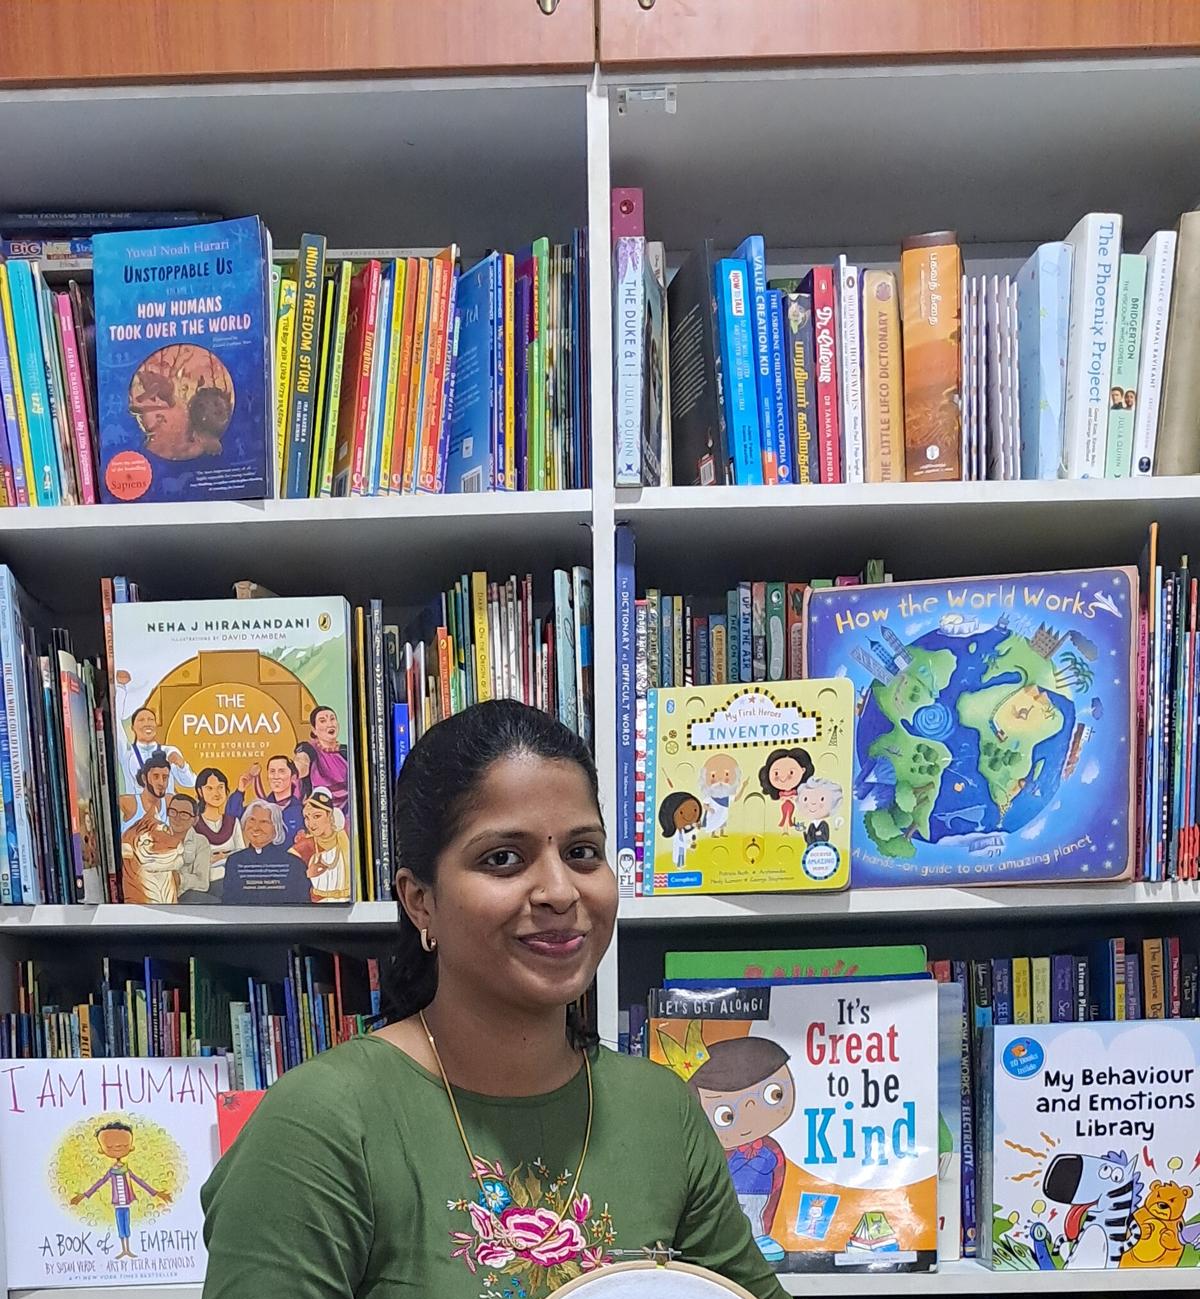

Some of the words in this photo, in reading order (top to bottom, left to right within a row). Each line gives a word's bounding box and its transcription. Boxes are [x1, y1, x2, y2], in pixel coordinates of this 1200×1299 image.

[127, 246, 156, 259] Yuval
[161, 245, 190, 256] Noah
[194, 240, 229, 252] Harari
[1098, 222, 1114, 256] The
[124, 262, 209, 283] Unstoppable
[216, 258, 233, 275] Us
[304, 247, 318, 288] INDIA'S
[732, 272, 740, 288] HOW
[755, 255, 764, 292] VALUE
[624, 280, 636, 304] THE
[770, 294, 778, 308] THE
[1090, 264, 1112, 336] Phoenix
[138, 303, 166, 319] HOW
[171, 296, 222, 316] HUMANS
[734, 298, 743, 314] TALK
[816, 307, 832, 326] Dr
[110, 325, 142, 340] TOOK
[146, 322, 176, 338] OVER
[181, 319, 204, 335] THE
[209, 314, 251, 333] WORLD
[301, 294, 315, 350] FREEDOM
[624, 310, 636, 345] DUKE
[756, 297, 767, 353] CREATION
[771, 312, 780, 350] USBORNE
[1127, 298, 1139, 359] BRIDGERTON
[817, 330, 834, 383] Cuterus
[879, 312, 889, 378] DICTIONARY
[297, 355, 311, 393] STORY
[760, 356, 769, 375] KID
[773, 352, 783, 400] CHILDREN'S
[1089, 342, 1105, 403] Project
[1150, 349, 1159, 388] RAVIKANT
[625, 384, 634, 415] JULIA
[824, 396, 831, 405] DR
[880, 383, 890, 413] LIFCO
[625, 420, 634, 457] QUINN
[776, 403, 786, 463] ENCYCLOPEDIA
[881, 419, 891, 455] LITTLE
[1115, 441, 1123, 467] QUINN
[881, 462, 891, 482] THE
[112, 481, 146, 492] Sapiens
[742, 597, 750, 608] UP
[835, 608, 888, 634] How
[898, 593, 938, 618] the
[948, 585, 1015, 608] World
[1023, 587, 1098, 619] Works
[147, 621, 186, 632] NEHA
[191, 621, 198, 631] J
[205, 618, 310, 630] HIRANANDANI
[621, 591, 630, 650] DICTIONARY
[742, 612, 750, 624] IN
[251, 632, 286, 640] YAMBEM
[742, 630, 750, 646] THE
[5, 662, 14, 676] THE
[6, 679, 15, 696] GIRL
[621, 663, 630, 710] DIFFICULT
[8, 698, 16, 717] WHO
[216, 693, 245, 708] THE
[183, 711, 281, 735] PADMAS
[725, 713, 737, 722] My
[739, 708, 756, 717] First
[759, 708, 781, 718] Heroes
[9, 719, 18, 741] COULD
[622, 713, 630, 746] WORDS
[709, 722, 799, 740] INVENTORS
[11, 744, 19, 758] FIX
[200, 750, 265, 758] PERSEVERANCE
[12, 761, 23, 798] ANYTHING
[853, 849, 860, 858] A
[862, 853, 918, 873] hands-on
[921, 864, 951, 876] guide
[958, 862, 969, 873] to
[975, 863, 992, 873] our
[999, 854, 1050, 871] amazing
[1054, 834, 1092, 863] planet
[659, 1000, 688, 1014] LET'S
[694, 1001, 714, 1014] GET
[720, 999, 763, 1014] ALONG!
[837, 998, 870, 1025] It's
[806, 1022, 900, 1066] Great
[2, 1066, 25, 1112] I
[37, 1068, 86, 1107] AM
[101, 1064, 218, 1110] HUMAN
[827, 1072, 849, 1097] to
[861, 1069, 899, 1108] be
[1044, 1070, 1074, 1092] My
[1082, 1066, 1194, 1086] Behaviour
[1036, 1094, 1080, 1113] and
[1089, 1091, 1195, 1111] Emotions
[804, 1101, 919, 1166] Kind
[1076, 1119, 1154, 1141] Library
[38, 1236, 53, 1256] A
[56, 1232, 93, 1256] BOOK
[97, 1232, 114, 1254] of
[141, 1230, 198, 1252] EMPATHY
